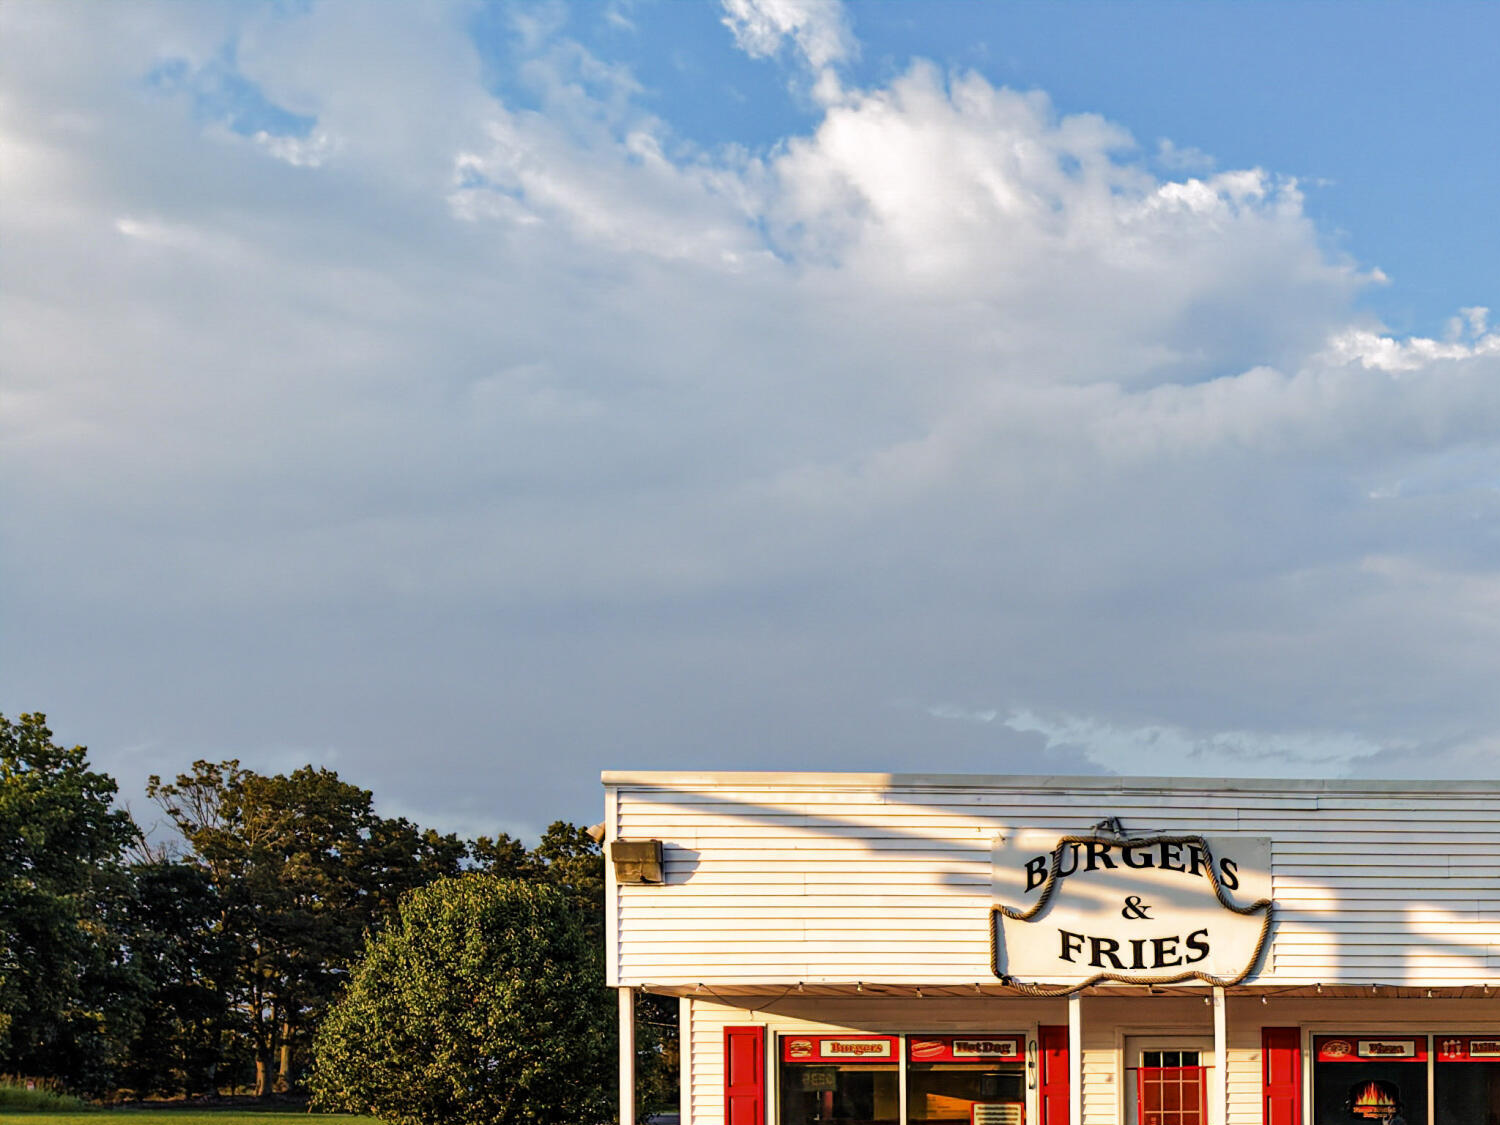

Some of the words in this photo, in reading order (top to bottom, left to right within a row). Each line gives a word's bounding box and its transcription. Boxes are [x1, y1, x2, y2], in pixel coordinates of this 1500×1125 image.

[1024, 838, 1239, 893] BURGERS
[1121, 895, 1154, 920] &
[1057, 928, 1210, 970] FRIES
[830, 1042, 883, 1055] Burgers
